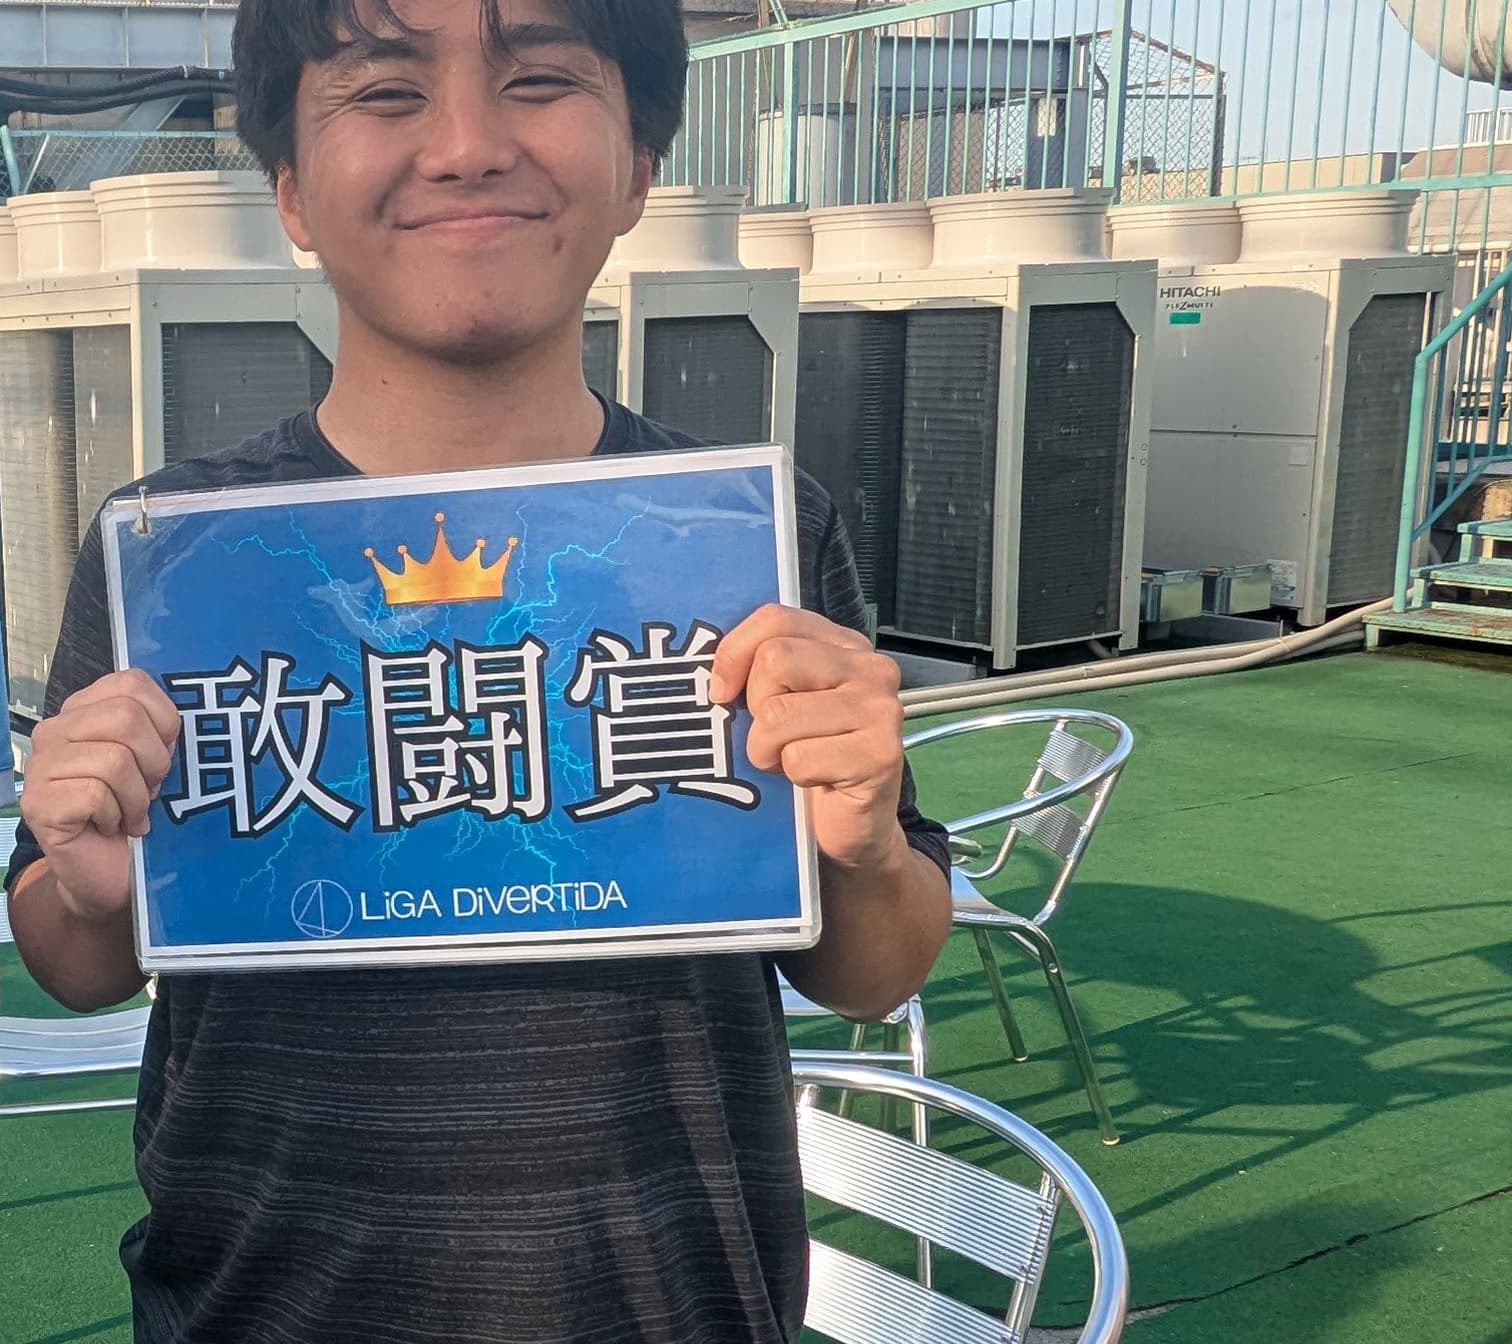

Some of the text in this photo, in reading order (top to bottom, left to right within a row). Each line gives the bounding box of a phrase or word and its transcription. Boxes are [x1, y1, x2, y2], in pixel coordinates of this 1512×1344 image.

[1159, 286, 1221, 298] HITACHI
[164, 623, 759, 836] 敢闘賞
